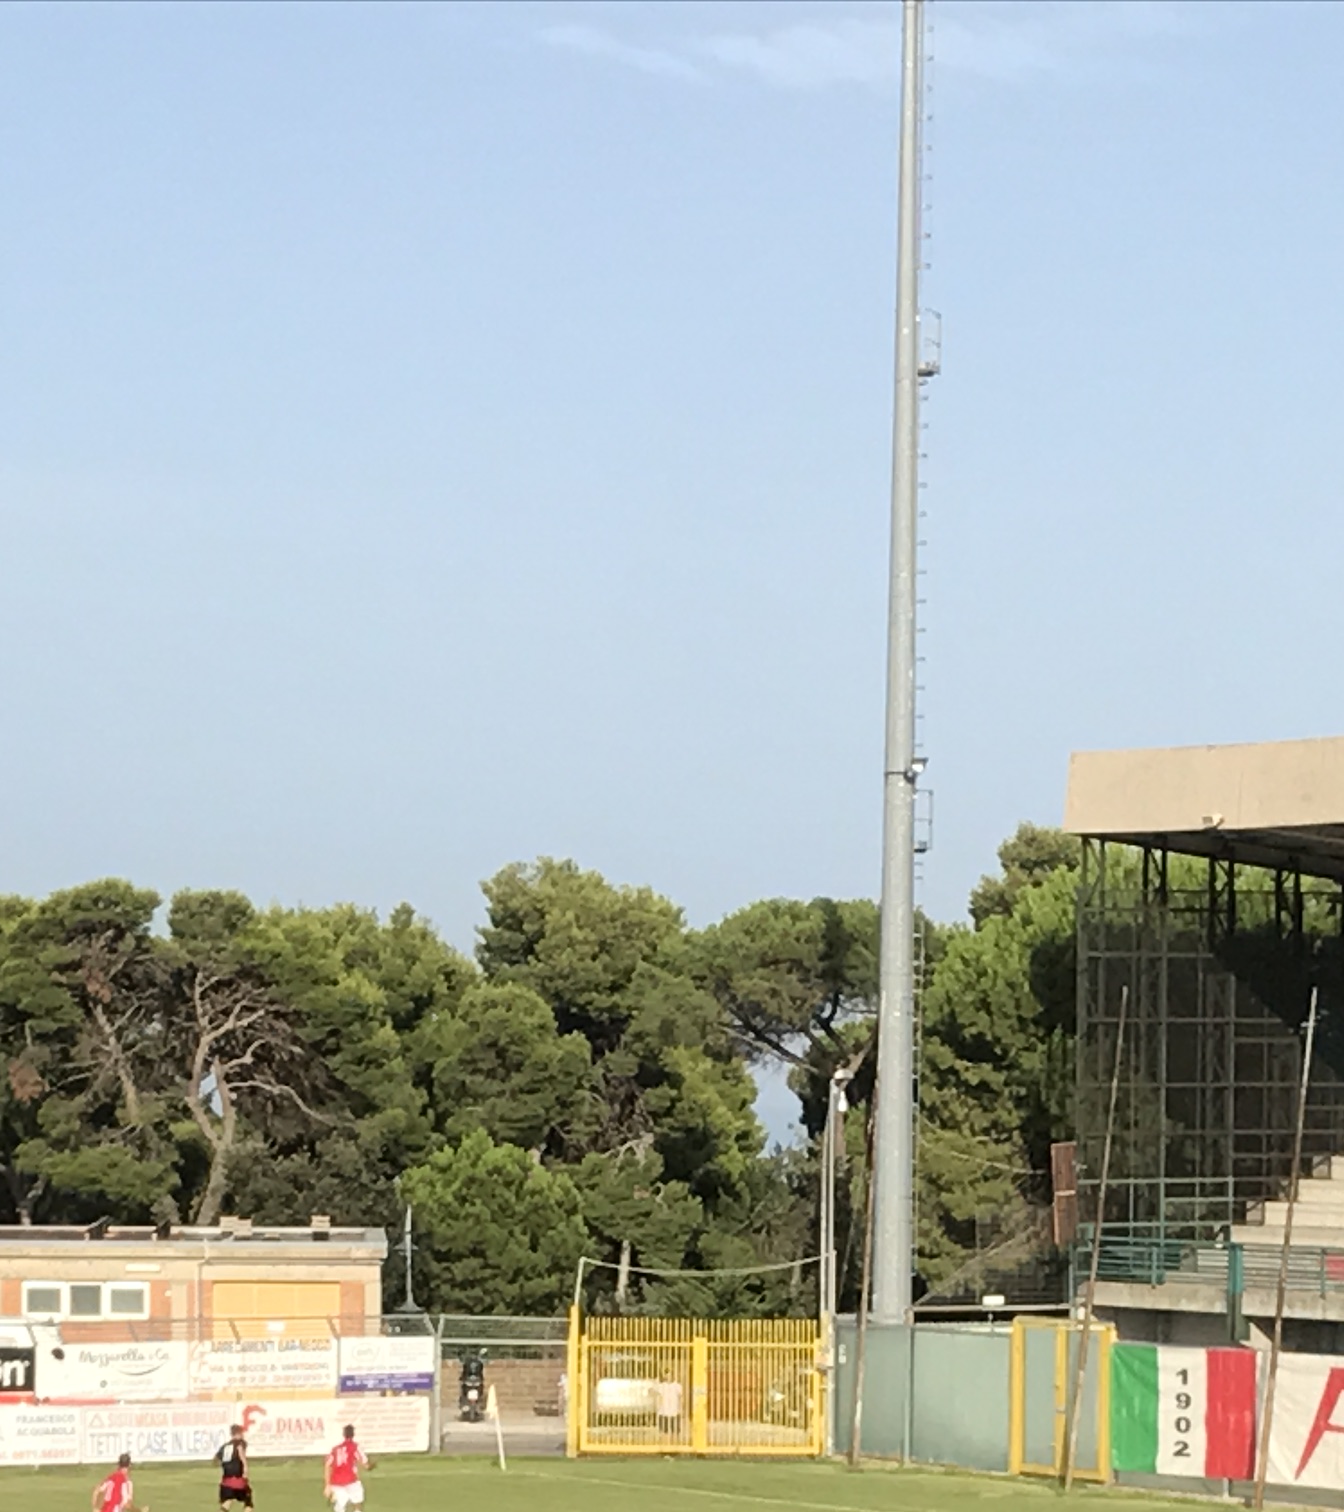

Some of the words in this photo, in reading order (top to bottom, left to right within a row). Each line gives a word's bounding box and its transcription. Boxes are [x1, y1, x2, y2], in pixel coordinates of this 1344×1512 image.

[275, 1417, 326, 1434] DIANA
[137, 1431, 168, 1455] CASE
[187, 1429, 227, 1454] LEGNO
